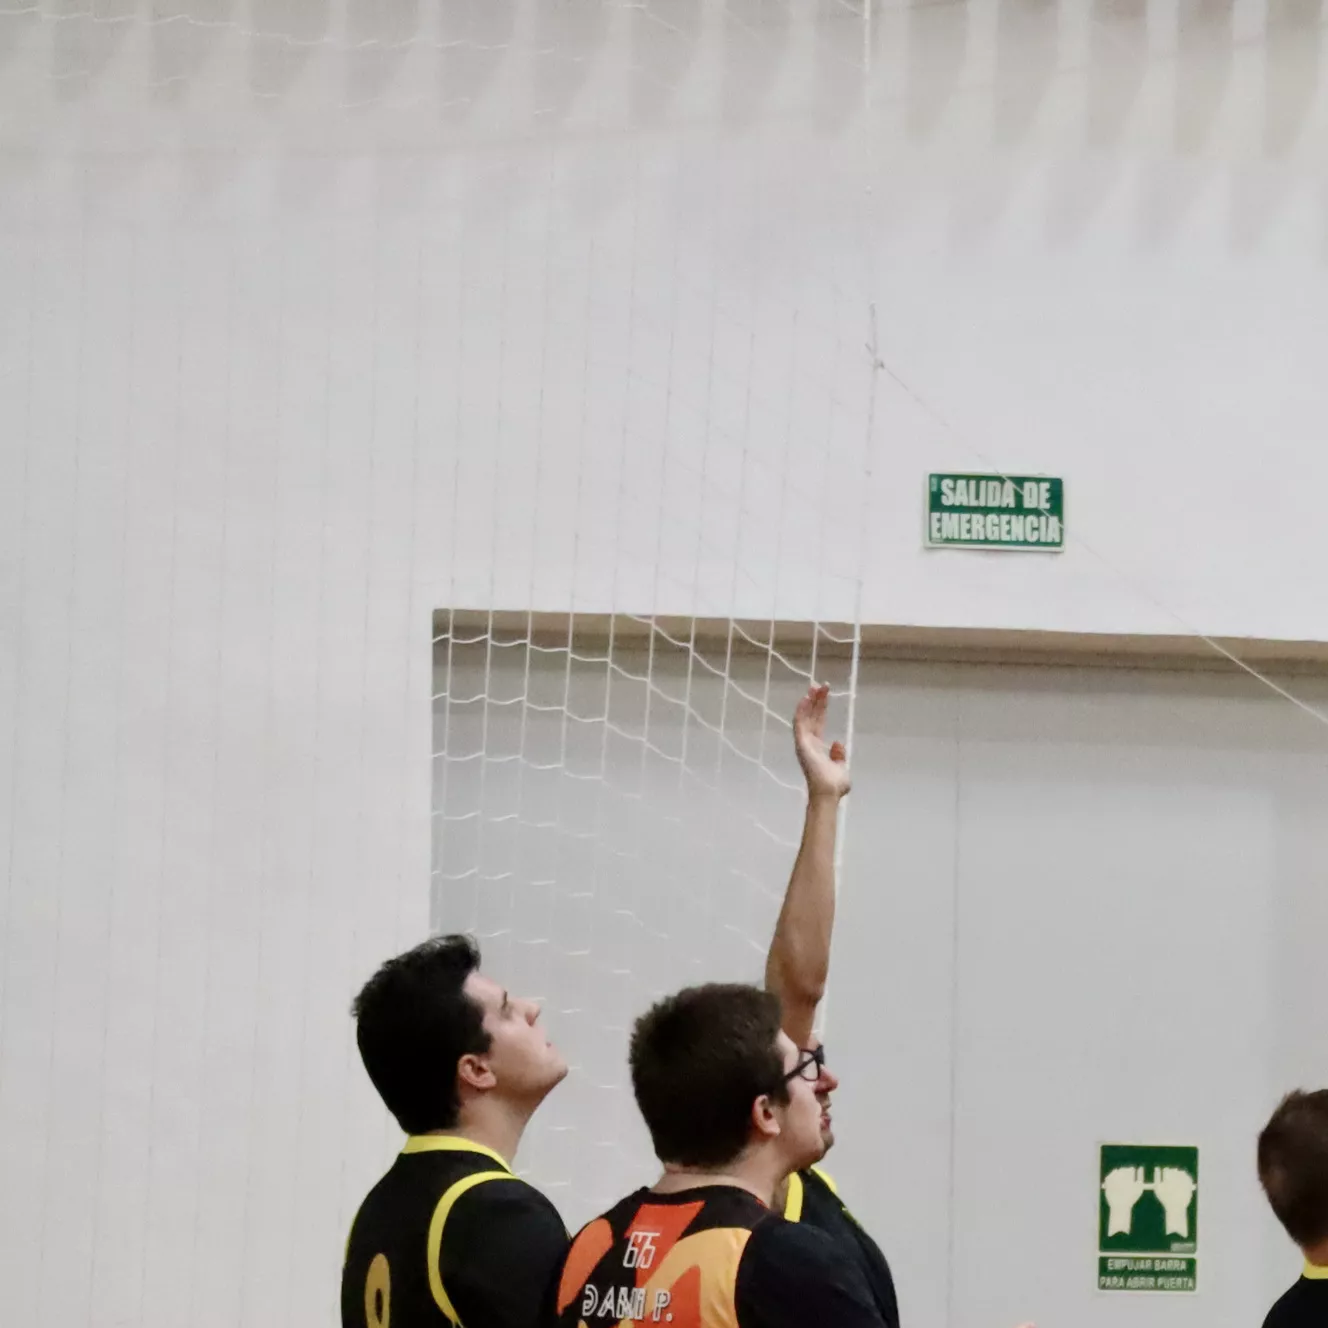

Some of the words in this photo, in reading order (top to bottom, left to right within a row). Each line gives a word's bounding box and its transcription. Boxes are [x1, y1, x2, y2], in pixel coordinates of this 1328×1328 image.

[941, 479, 1016, 508] SALIDA
[1023, 482, 1051, 509] DE
[930, 512, 1061, 543] EMERGENCIA
[1107, 1258, 1152, 1271] EMPUJAR
[1154, 1259, 1187, 1272] BARRA
[1099, 1276, 1125, 1289] PARA
[1126, 1276, 1155, 1289] ABRIR
[1157, 1277, 1194, 1290] PUERTA
[581, 1284, 646, 1320] DANI
[652, 1288, 674, 1322] P.
